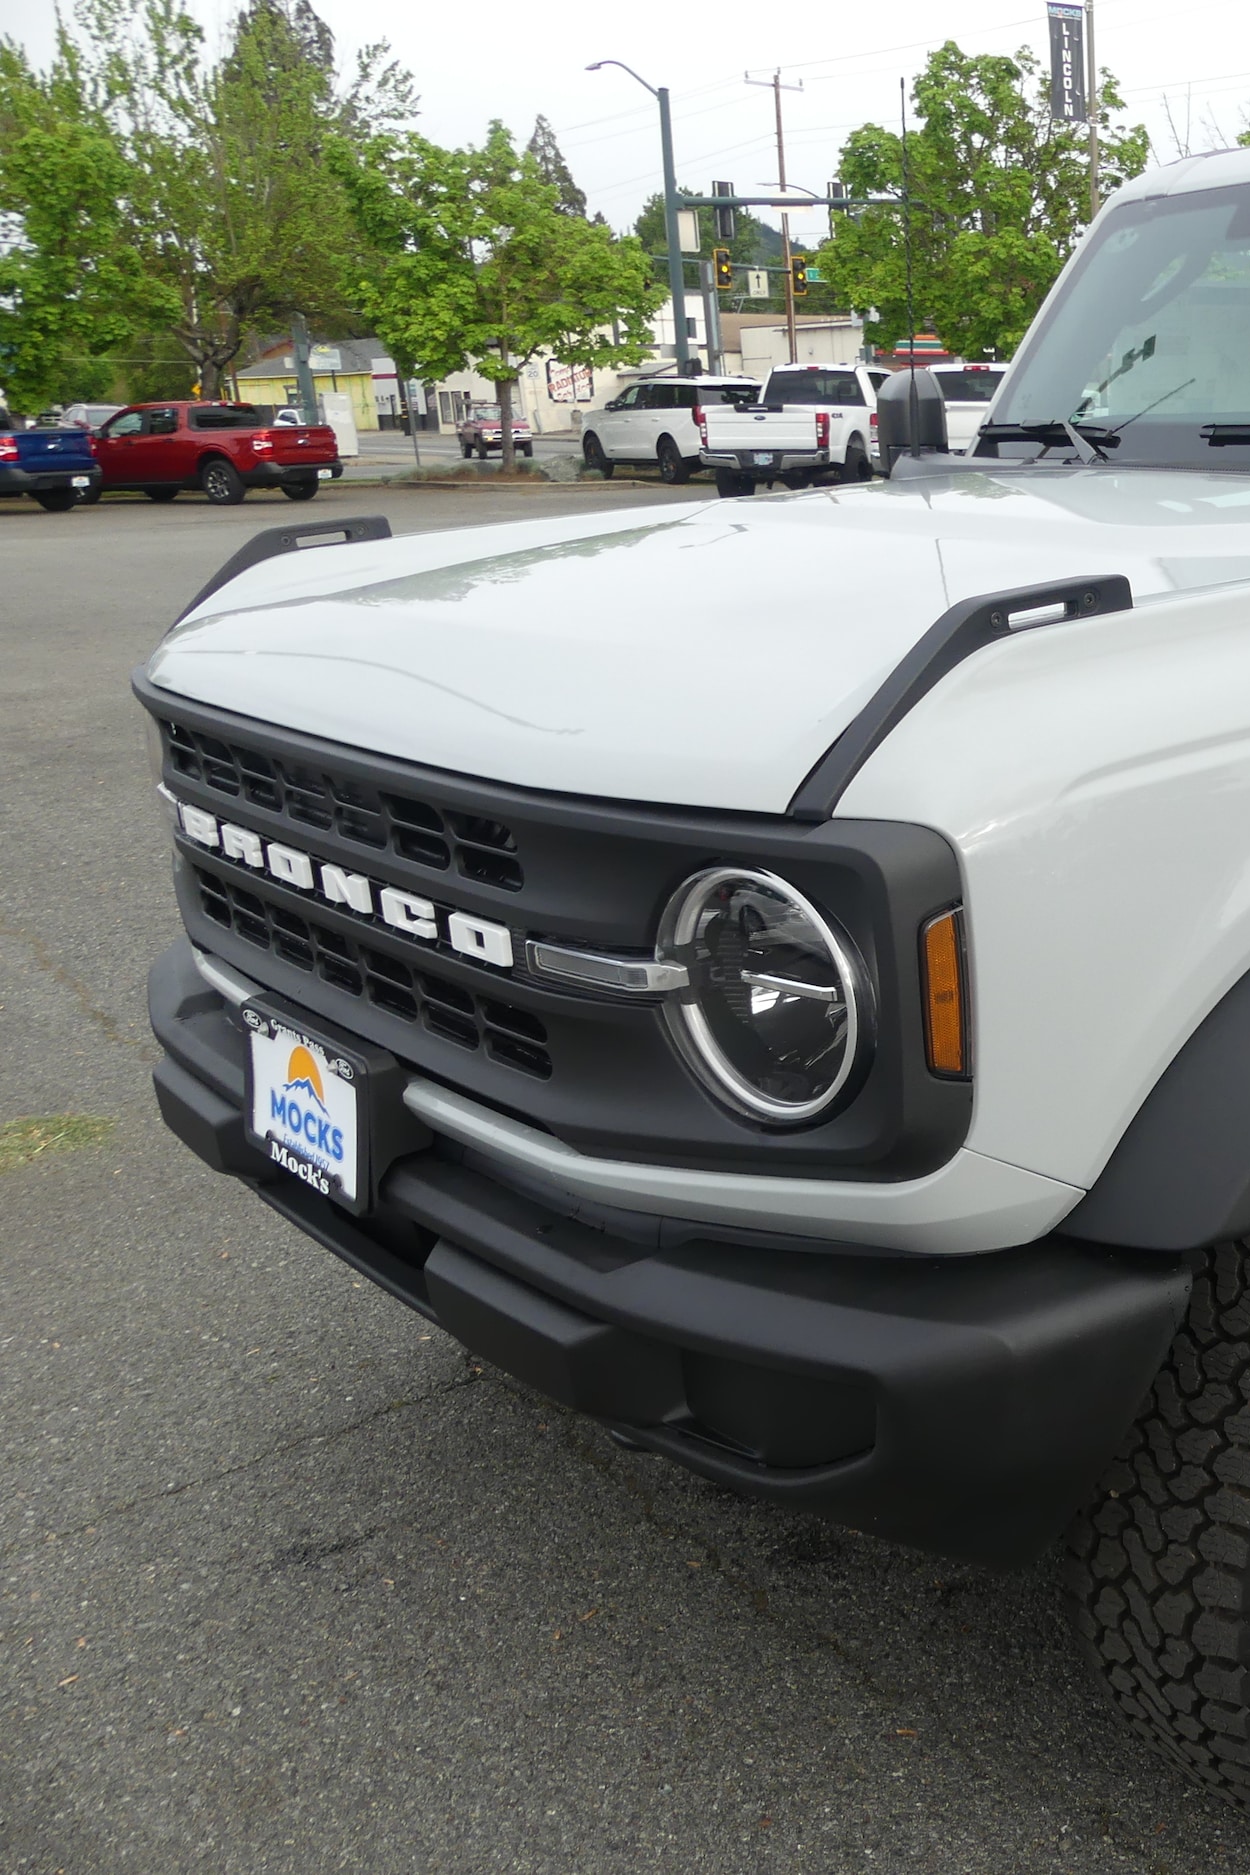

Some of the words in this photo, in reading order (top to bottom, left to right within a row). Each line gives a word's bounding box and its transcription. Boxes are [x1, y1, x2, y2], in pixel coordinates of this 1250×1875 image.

[1062, 22, 1074, 116] LINCOLN
[182, 804, 514, 968] BRONCO
[302, 1035, 325, 1056] Pass
[271, 1087, 344, 1162] MOCKS
[270, 1141, 330, 1194] Mock's
